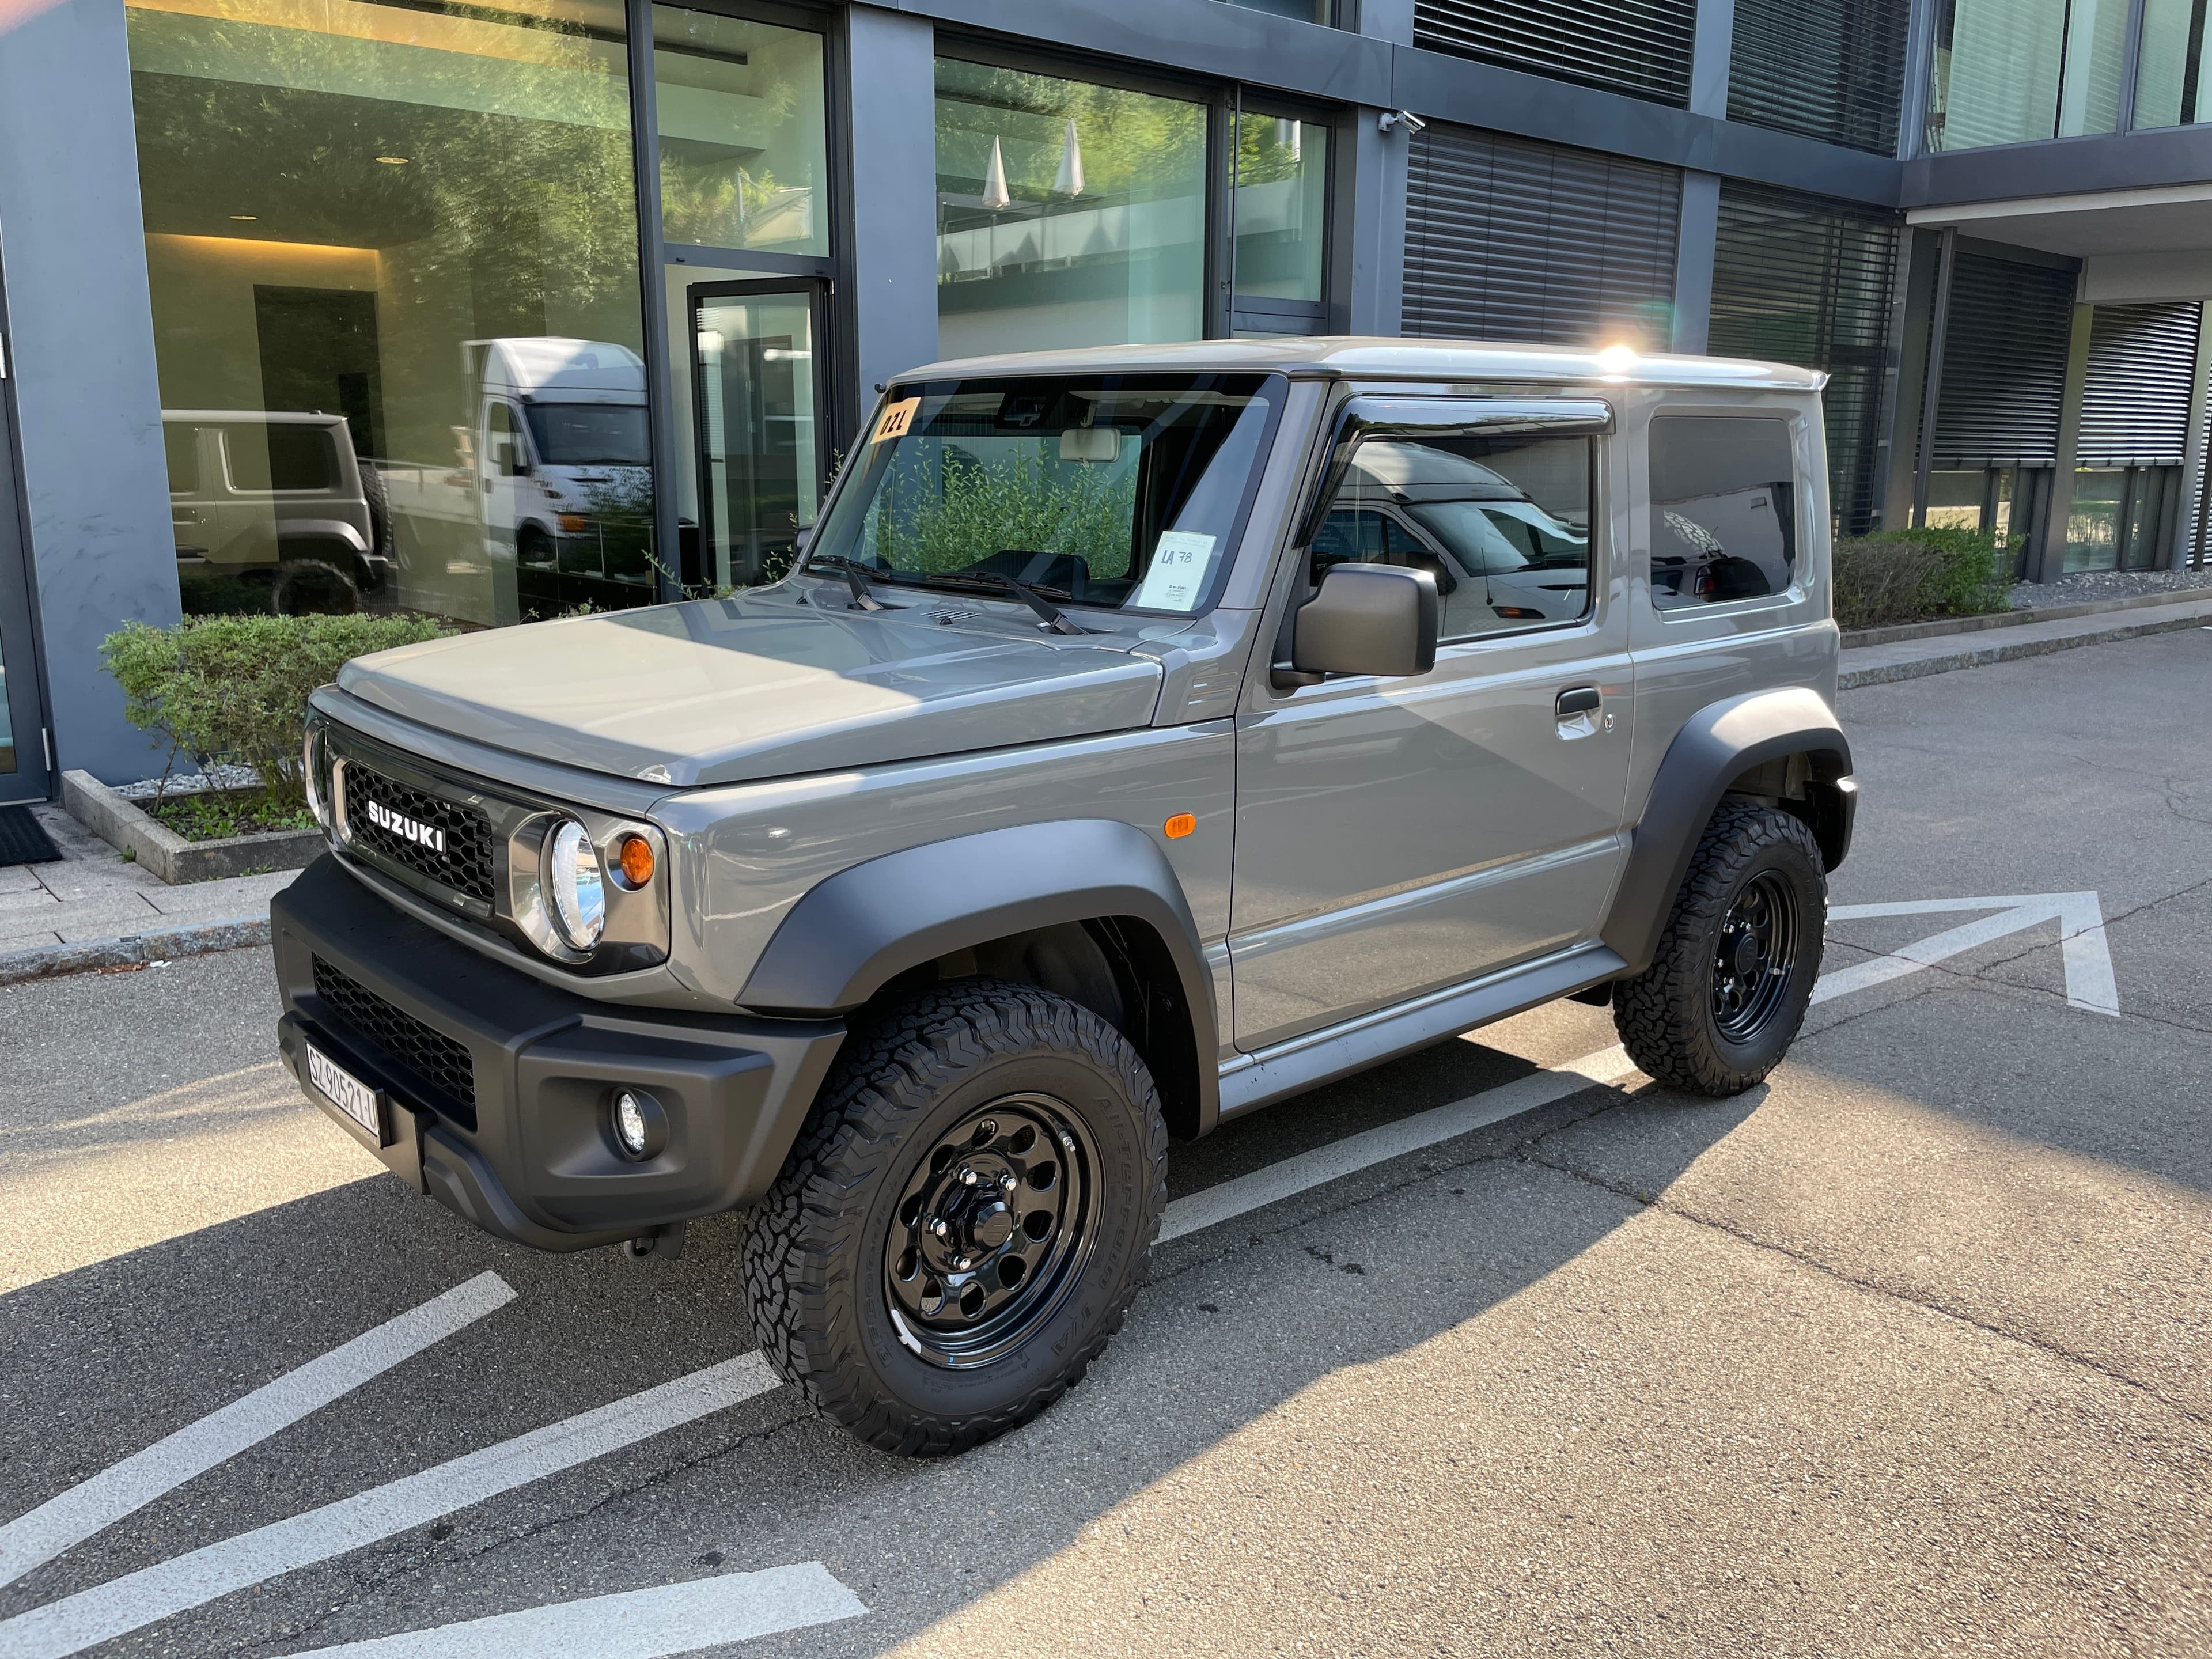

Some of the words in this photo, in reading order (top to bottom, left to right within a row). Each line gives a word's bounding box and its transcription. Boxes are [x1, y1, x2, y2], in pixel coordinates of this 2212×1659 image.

[1161, 550, 1175, 565] LA
[1179, 551, 1192, 563] 78
[368, 800, 443, 852] SUZUKI
